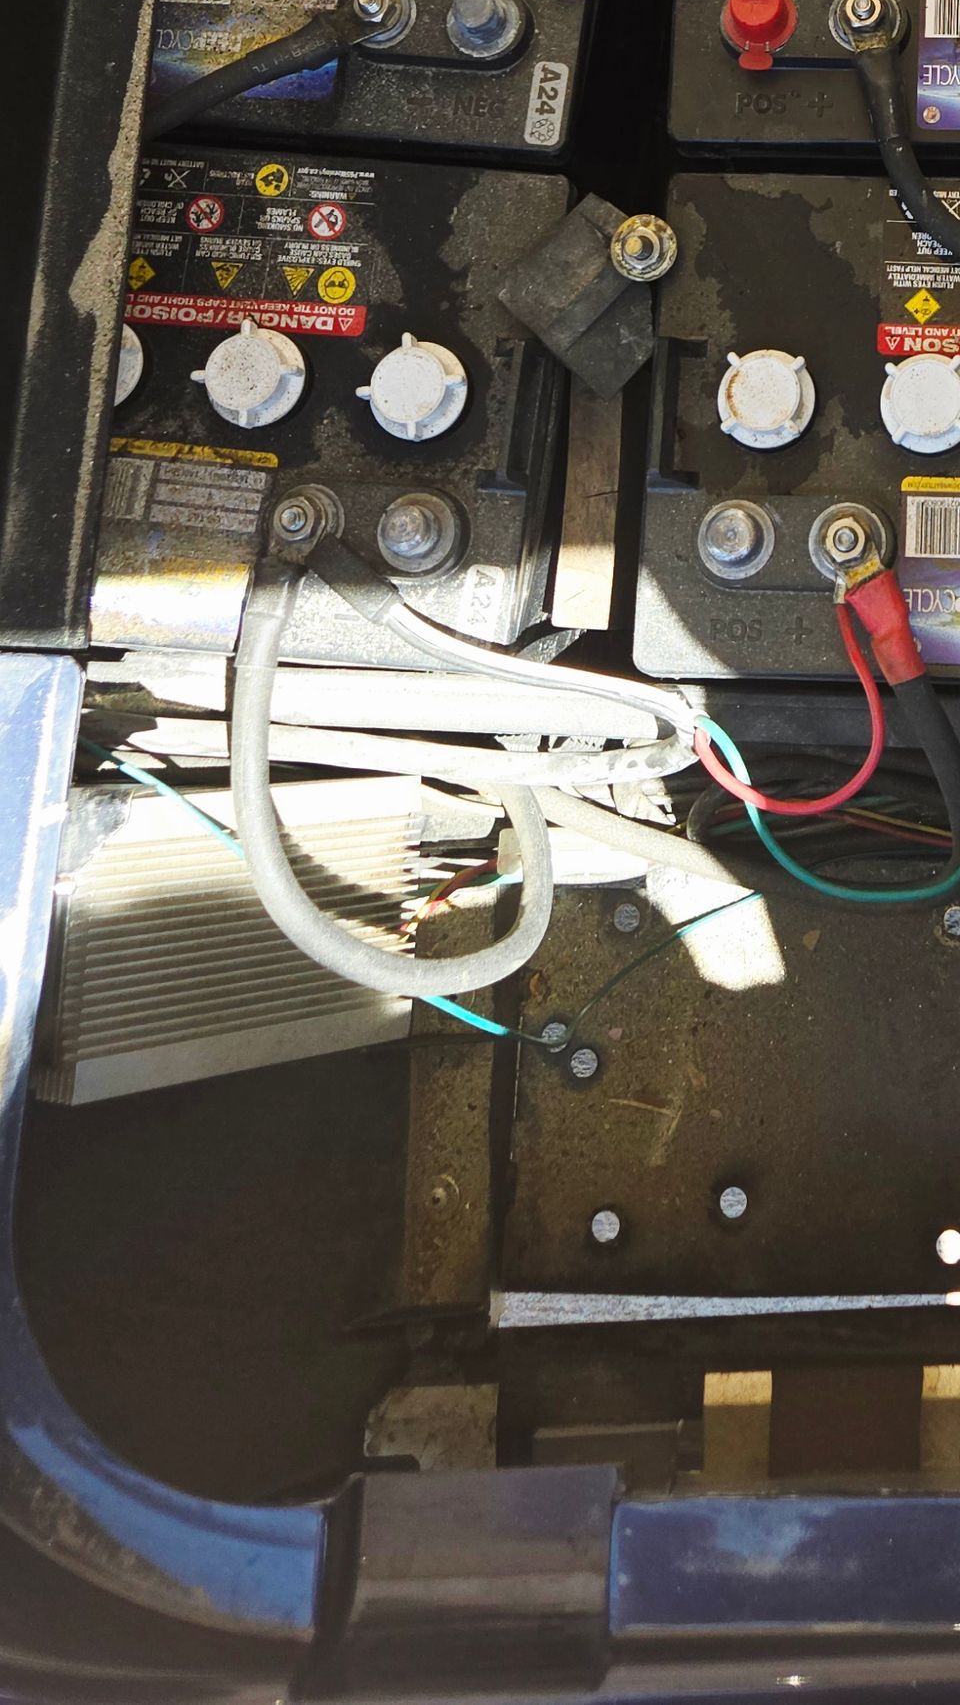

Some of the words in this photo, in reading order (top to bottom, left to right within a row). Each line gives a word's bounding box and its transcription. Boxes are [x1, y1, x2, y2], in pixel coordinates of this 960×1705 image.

[535, 65, 561, 116] A24
[736, 92, 786, 114] POS
[916, 247, 932, 255] OUT
[922, 266, 949, 274] MEDICAL
[936, 274, 960, 282] WATER
[932, 281, 954, 289] FLUSH
[260, 303, 290, 312] KEEP
[292, 304, 310, 314] TIP.
[311, 306, 337, 315] NOT
[338, 308, 356, 316] DO
[885, 327, 922, 336] LEVEL.
[925, 328, 949, 337] AND
